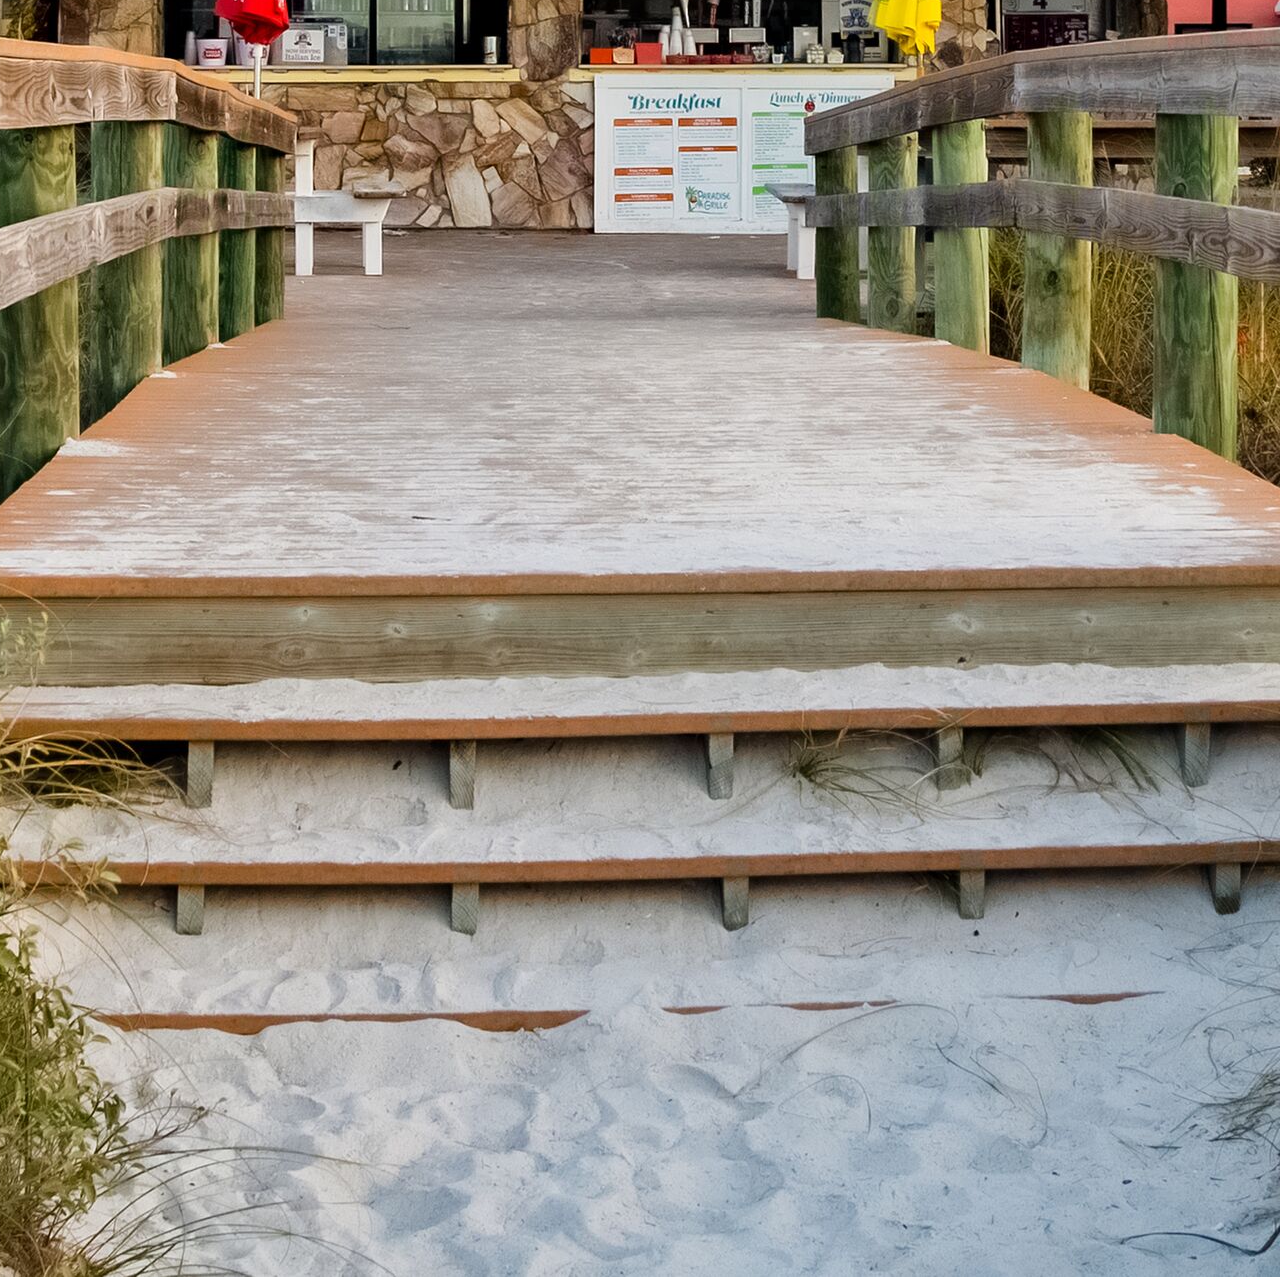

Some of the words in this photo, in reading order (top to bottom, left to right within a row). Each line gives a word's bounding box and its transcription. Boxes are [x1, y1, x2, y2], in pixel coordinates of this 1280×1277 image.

[1063, 29, 1088, 44] $15
[628, 93, 721, 113] Breakfast
[770, 92, 804, 107] Lunch
[697, 191, 731, 200] PARADISE
[704, 200, 728, 210] GRILLE
